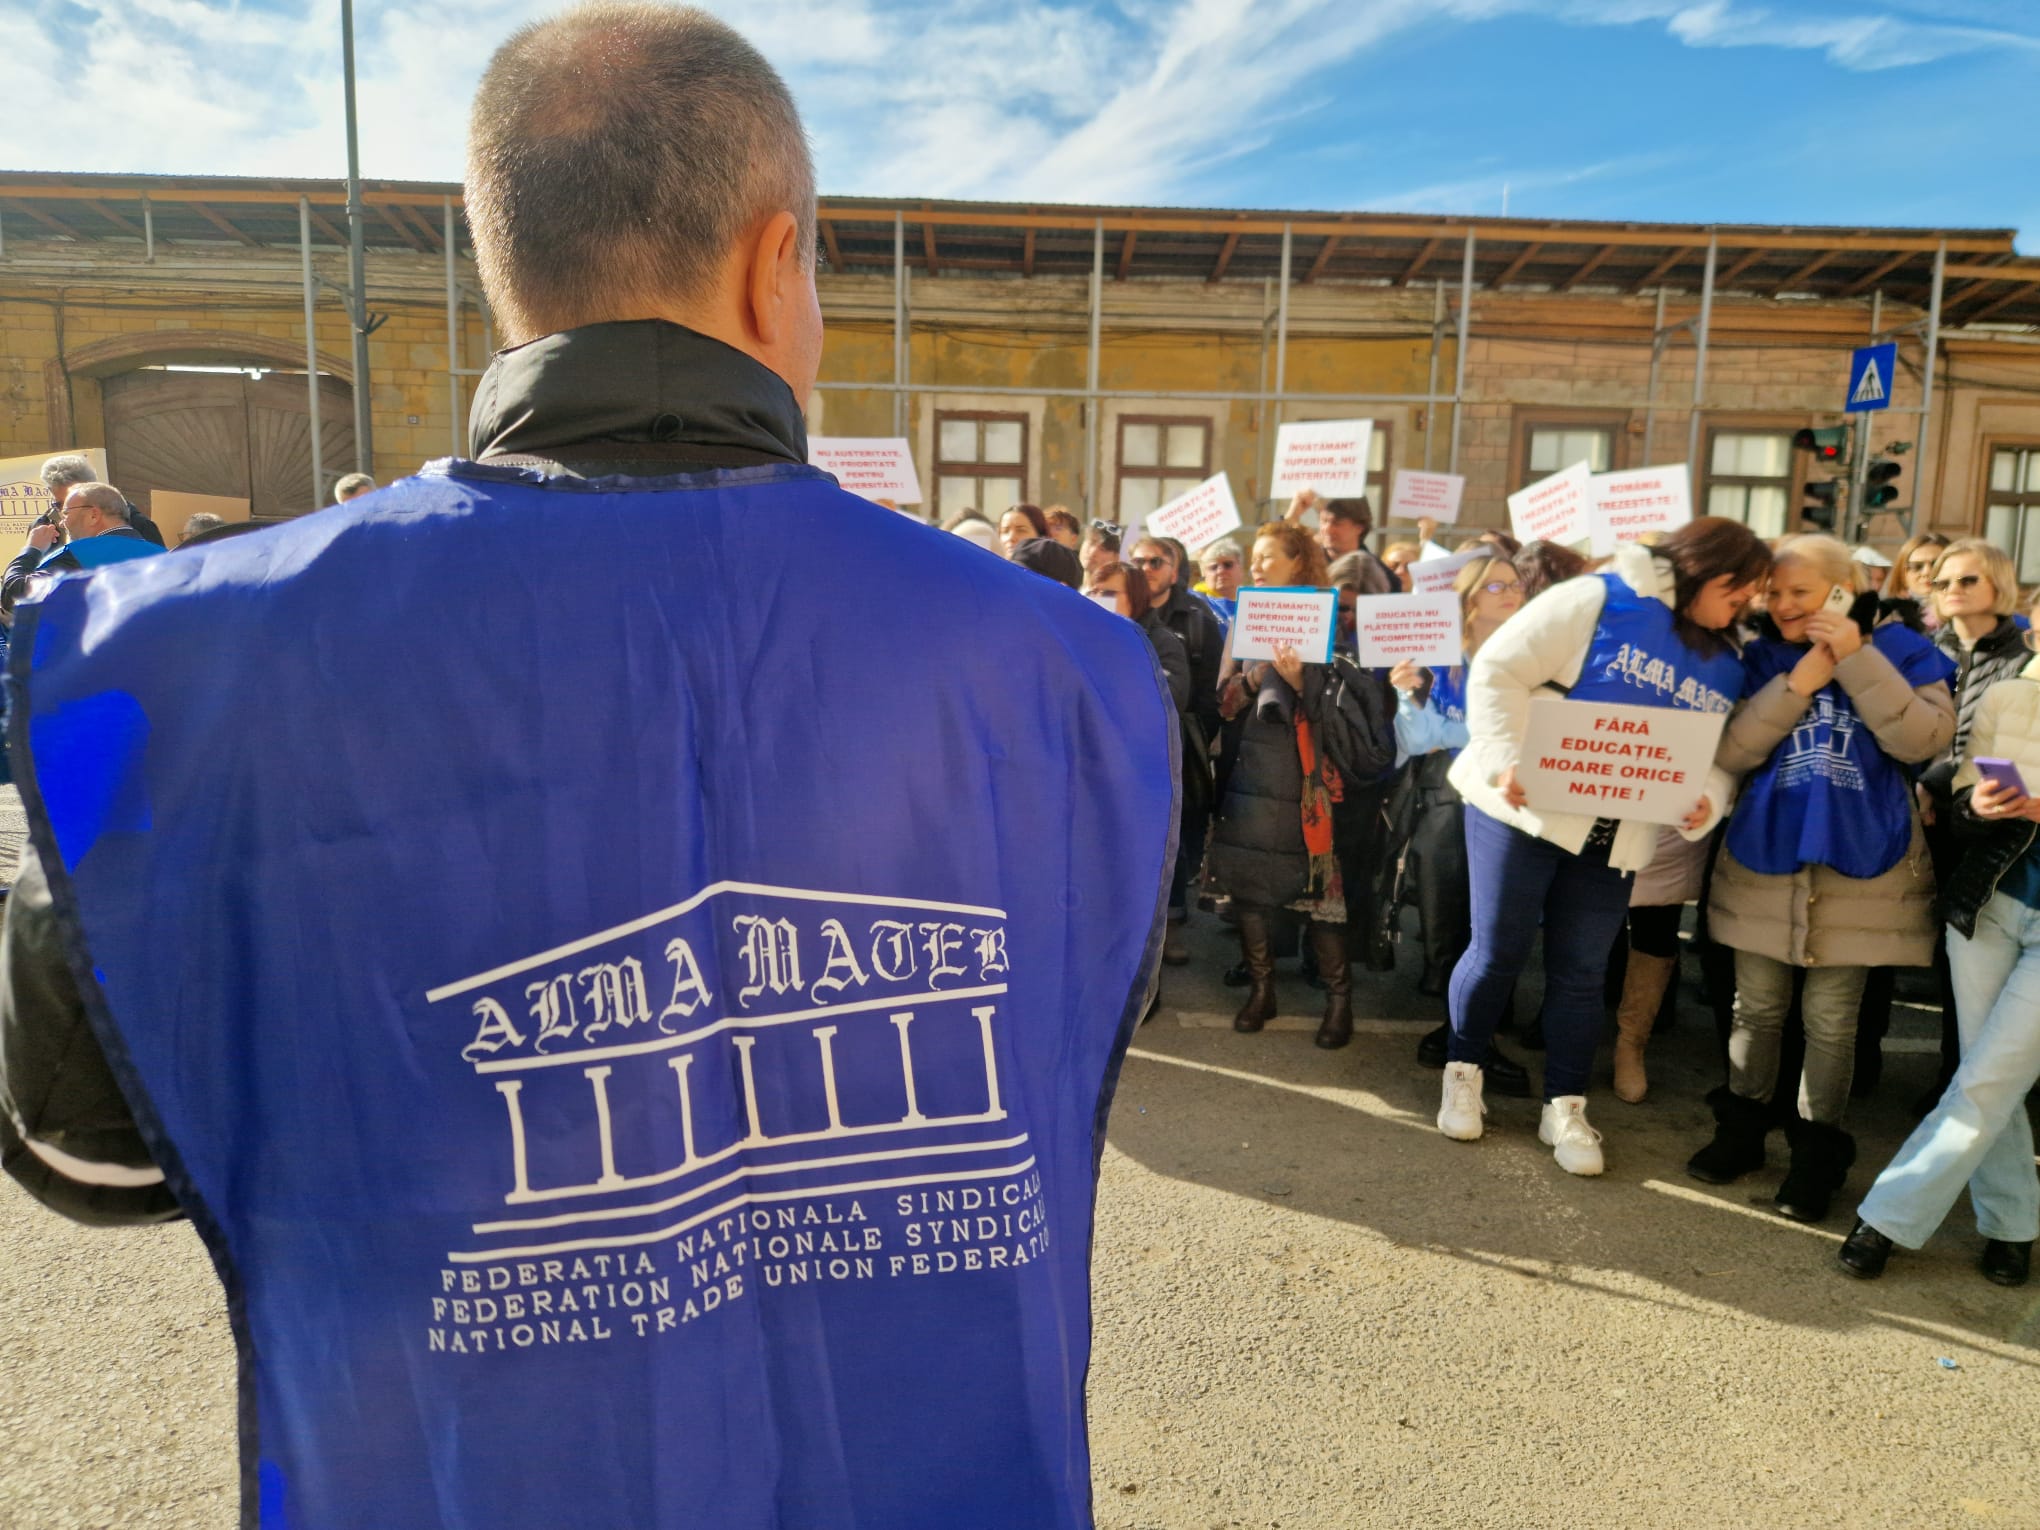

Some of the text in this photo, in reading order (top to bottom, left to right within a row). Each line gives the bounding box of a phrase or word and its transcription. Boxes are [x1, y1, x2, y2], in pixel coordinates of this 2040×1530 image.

[845, 471, 885, 479] PENTRU
[1248, 613, 1294, 622] SUPERIOR
[1425, 609, 1439, 617] NU
[1413, 621, 1452, 629] PENTRU
[1593, 717, 1650, 736] FĂRĂ
[1560, 737, 1673, 762] EDUCAȚIE,
[1539, 757, 1686, 783] MOARE ORICE
[1568, 782, 1645, 801] NAȚIE !
[461, 914, 1010, 1063] ALMA MATER
[441, 1252, 656, 1293] FEDERATIA
[677, 1200, 867, 1263] NATIONALA
[432, 1277, 670, 1324] FEDERATION
[691, 1227, 882, 1288] NATIONALE
[428, 1316, 611, 1353] NATIONAL
[631, 1274, 744, 1337] TRADE
[764, 1258, 873, 1287] UNION
